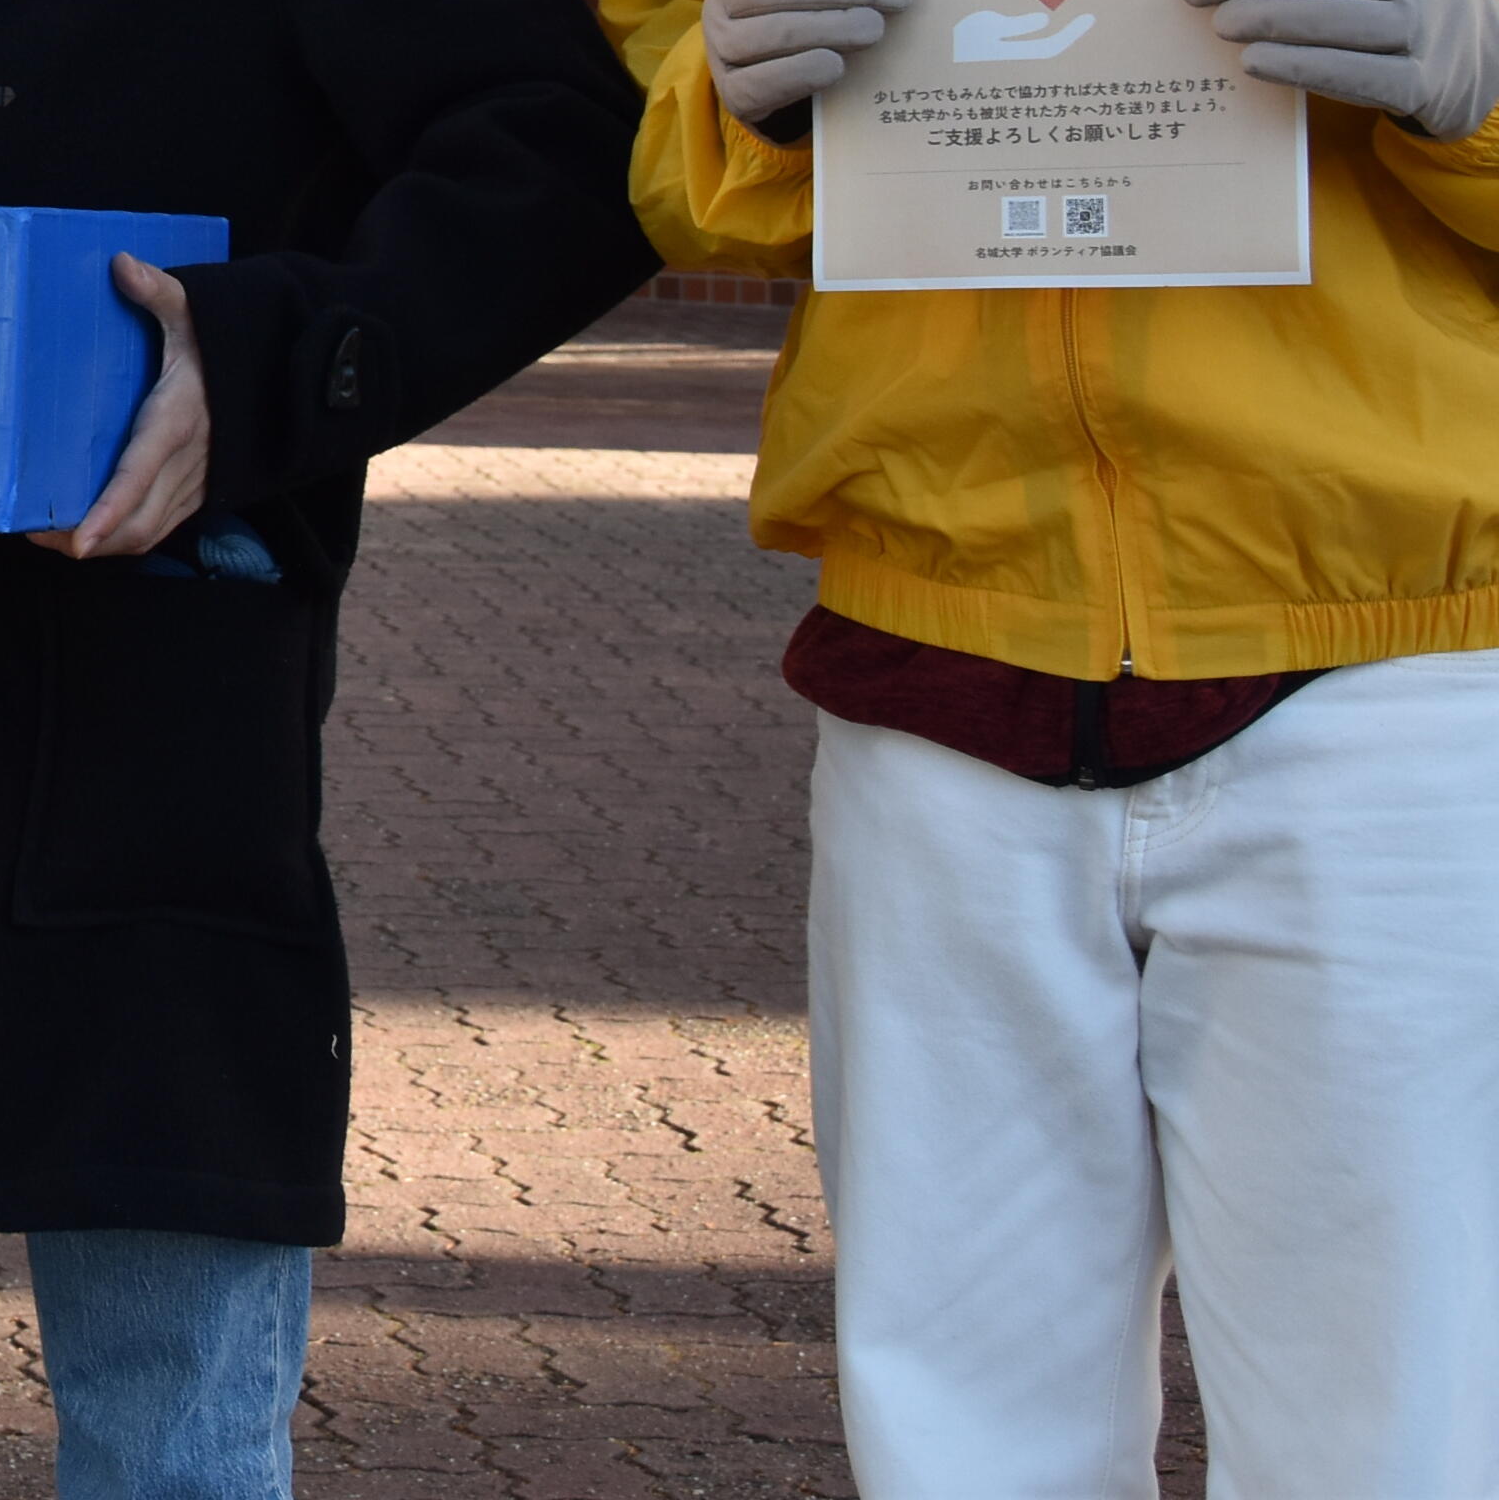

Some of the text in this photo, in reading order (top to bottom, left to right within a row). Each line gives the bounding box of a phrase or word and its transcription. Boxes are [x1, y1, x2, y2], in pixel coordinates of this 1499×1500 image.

[875, 78, 1235, 104] 少しずつでもみんなで協力すれば大きな力となります。
[928, 121, 1185, 146] ご支援よろしくお願いします
[968, 176, 1131, 191] お問い合わせはこちらから
[976, 245, 1136, 259] 名城大学 ボランティア協議会
